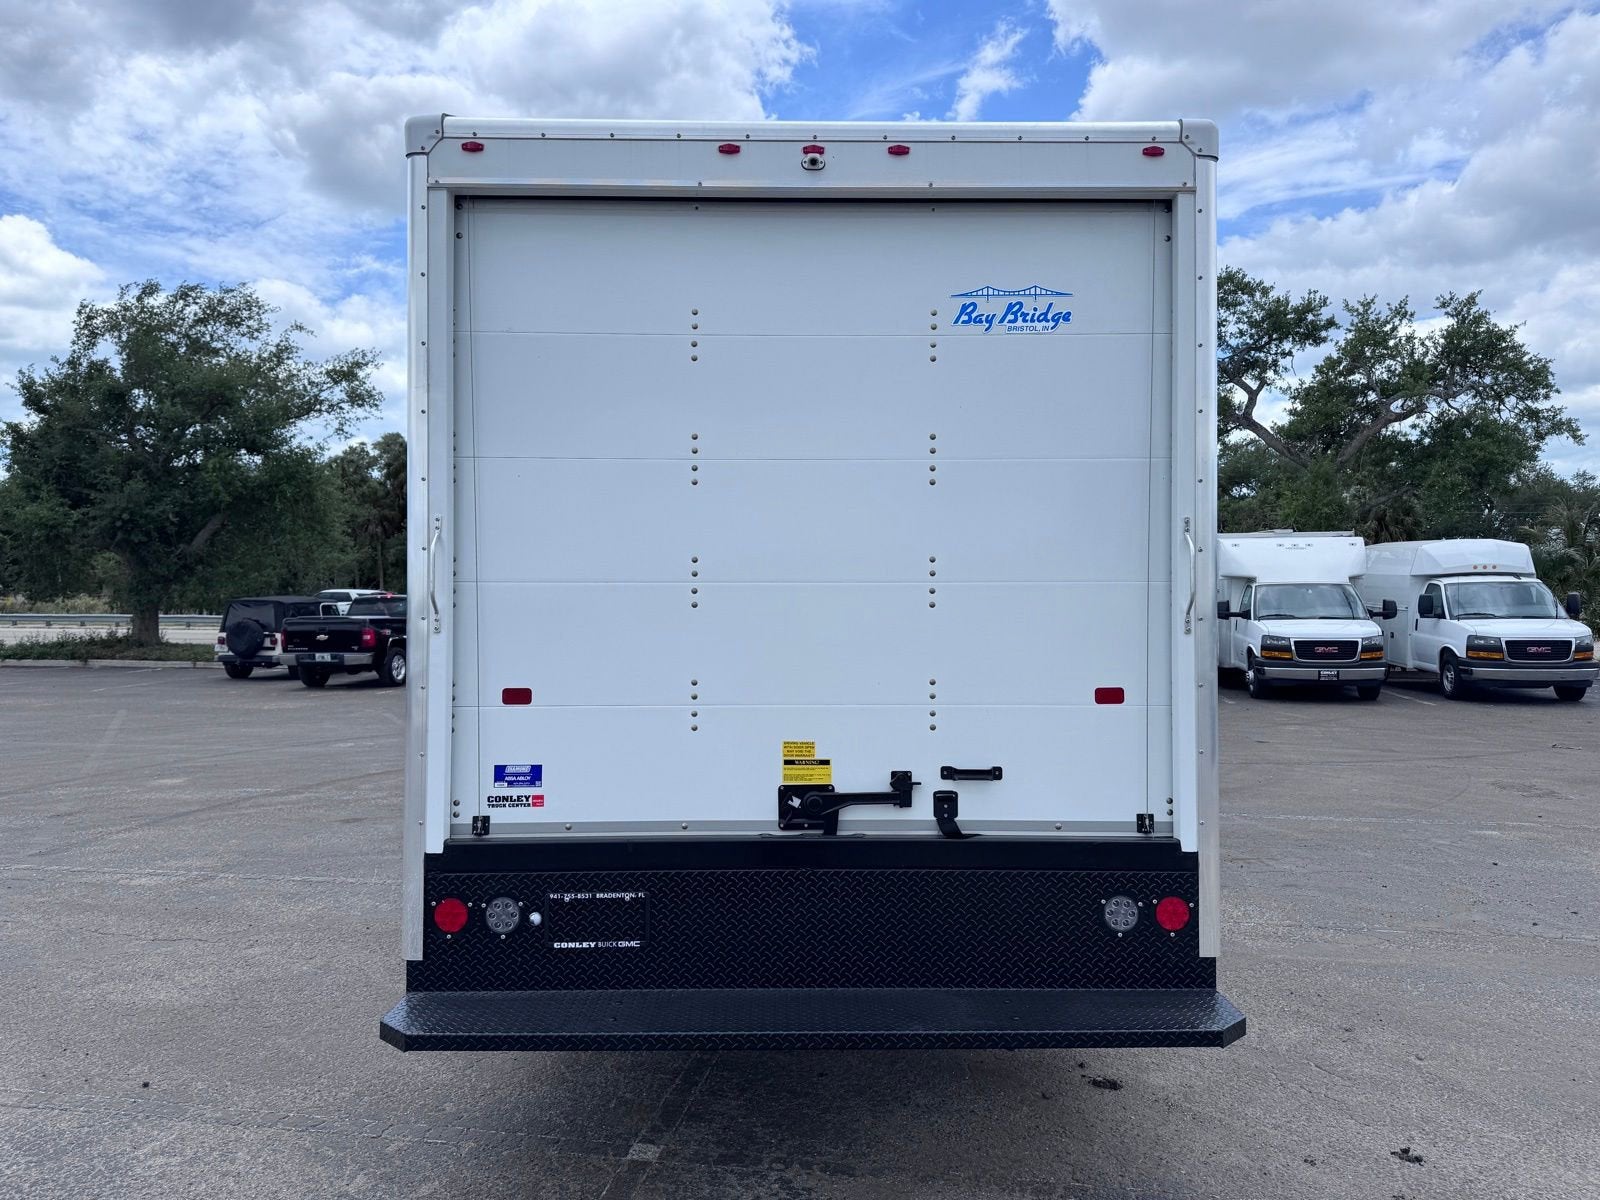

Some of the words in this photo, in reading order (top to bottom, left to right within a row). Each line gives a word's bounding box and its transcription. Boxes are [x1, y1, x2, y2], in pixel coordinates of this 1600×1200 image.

[952, 301, 997, 332] Bay
[997, 301, 1073, 330] Bridge
[487, 794, 532, 803] CONLEY
[553, 941, 597, 949] CONLEY
